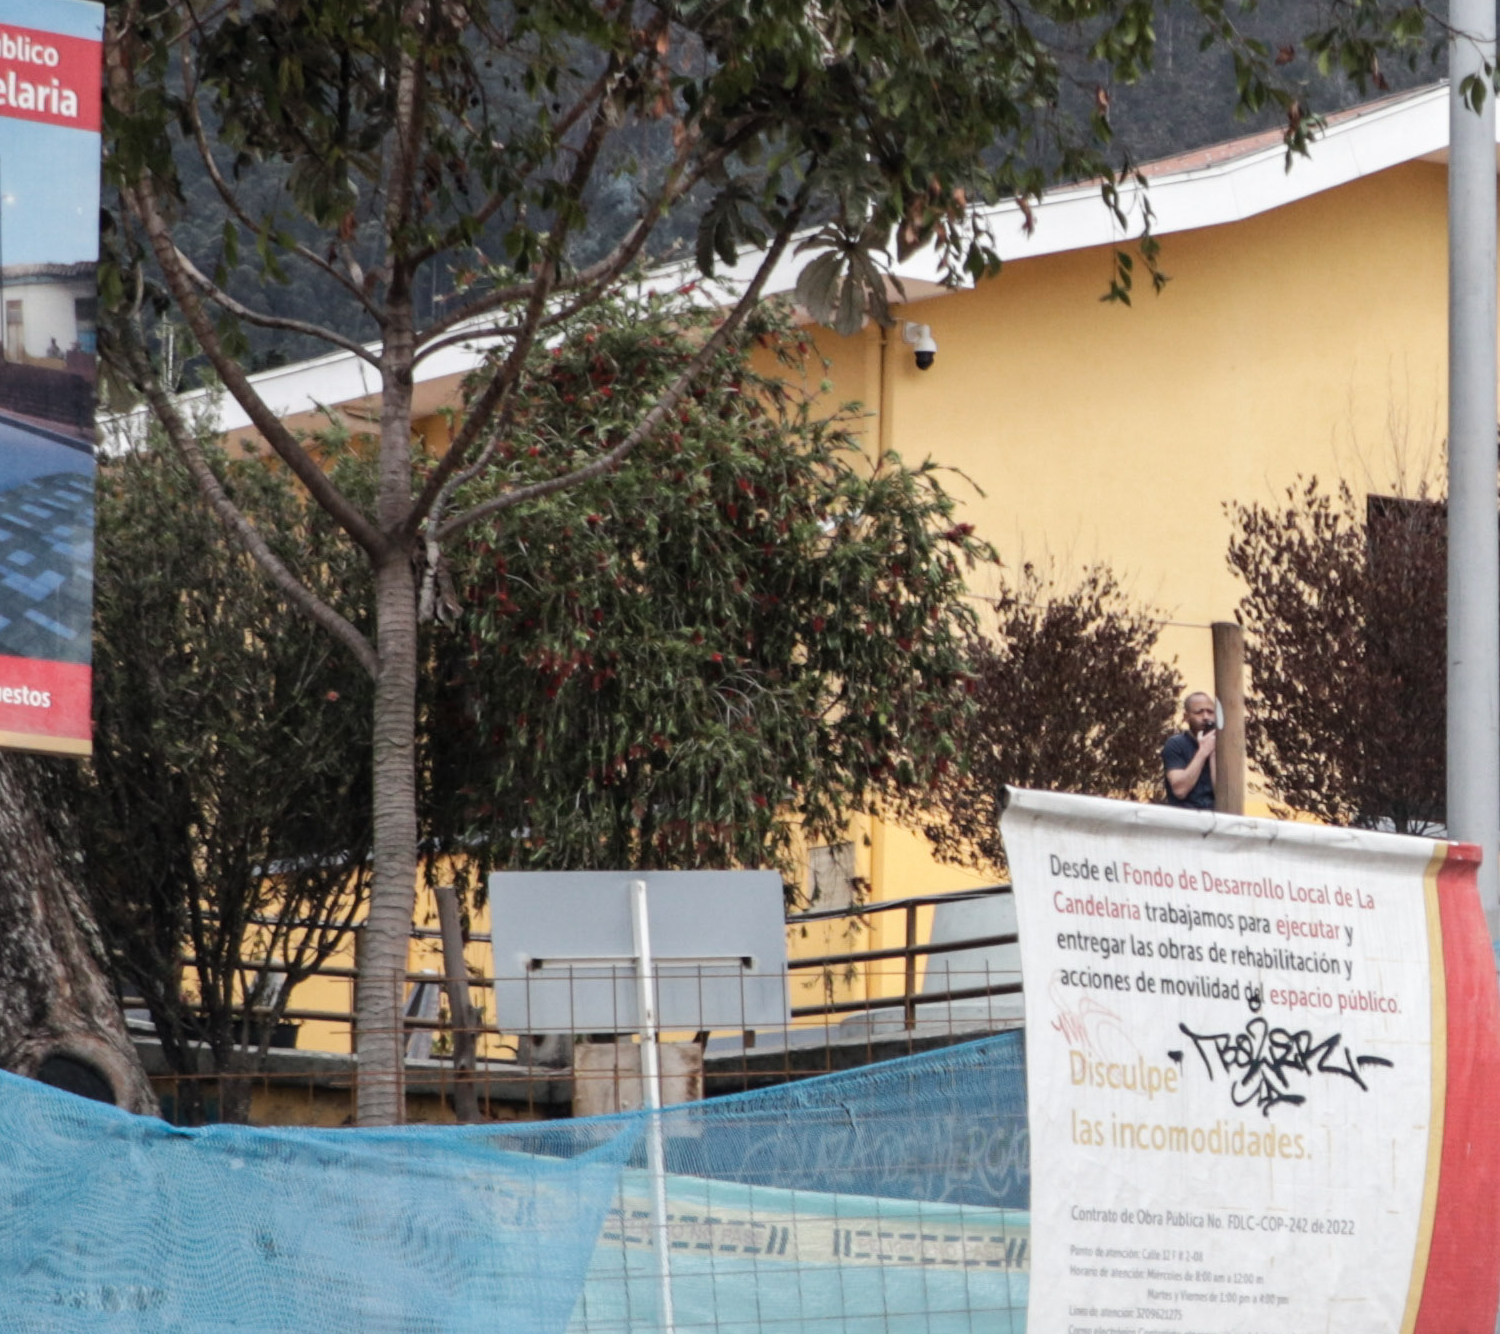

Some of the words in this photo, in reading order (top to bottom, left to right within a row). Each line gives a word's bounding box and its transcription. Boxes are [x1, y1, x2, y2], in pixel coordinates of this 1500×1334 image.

[1050, 854, 1100, 881] Desde
[1104, 861, 1120, 883] el
[1123, 862, 1174, 889] Fondo
[1178, 869, 1198, 891] de
[1202, 871, 1285, 899] Desarrollo
[1289, 879, 1331, 905] Local
[1334, 885, 1353, 908] de
[1356, 889, 1376, 910] La
[1053, 891, 1142, 920] Candelaria
[1145, 900, 1235, 931] trabajamos
[1238, 914, 1271, 935] para
[1276, 915, 1340, 940] ejecutar
[1344, 924, 1353, 946] y
[1057, 931, 1125, 960] entregar
[1131, 935, 1153, 958] las
[1159, 938, 1202, 962] obras
[1209, 943, 1228, 964] de
[1232, 946, 1340, 975] rehabilitación
[1343, 958, 1352, 981] y
[1060, 967, 1131, 992] acciones
[1136, 971, 1156, 994] de
[1161, 975, 1239, 1002] movilidad
[1270, 986, 1332, 1011] espacio
[1339, 990, 1402, 1015] público.
[1069, 1049, 1178, 1100] Disculpe
[1072, 1109, 1109, 1146] las
[1112, 1112, 1312, 1160] incomodidades.
[1071, 1205, 1118, 1224] Contrato
[1121, 1209, 1134, 1223] de
[1137, 1209, 1163, 1226] Obra
[1208, 1214, 1224, 1229] No.
[1228, 1215, 1308, 1233] FDLC-COP-242
[1311, 1219, 1324, 1233] de
[1326, 1220, 1355, 1235] 2022
